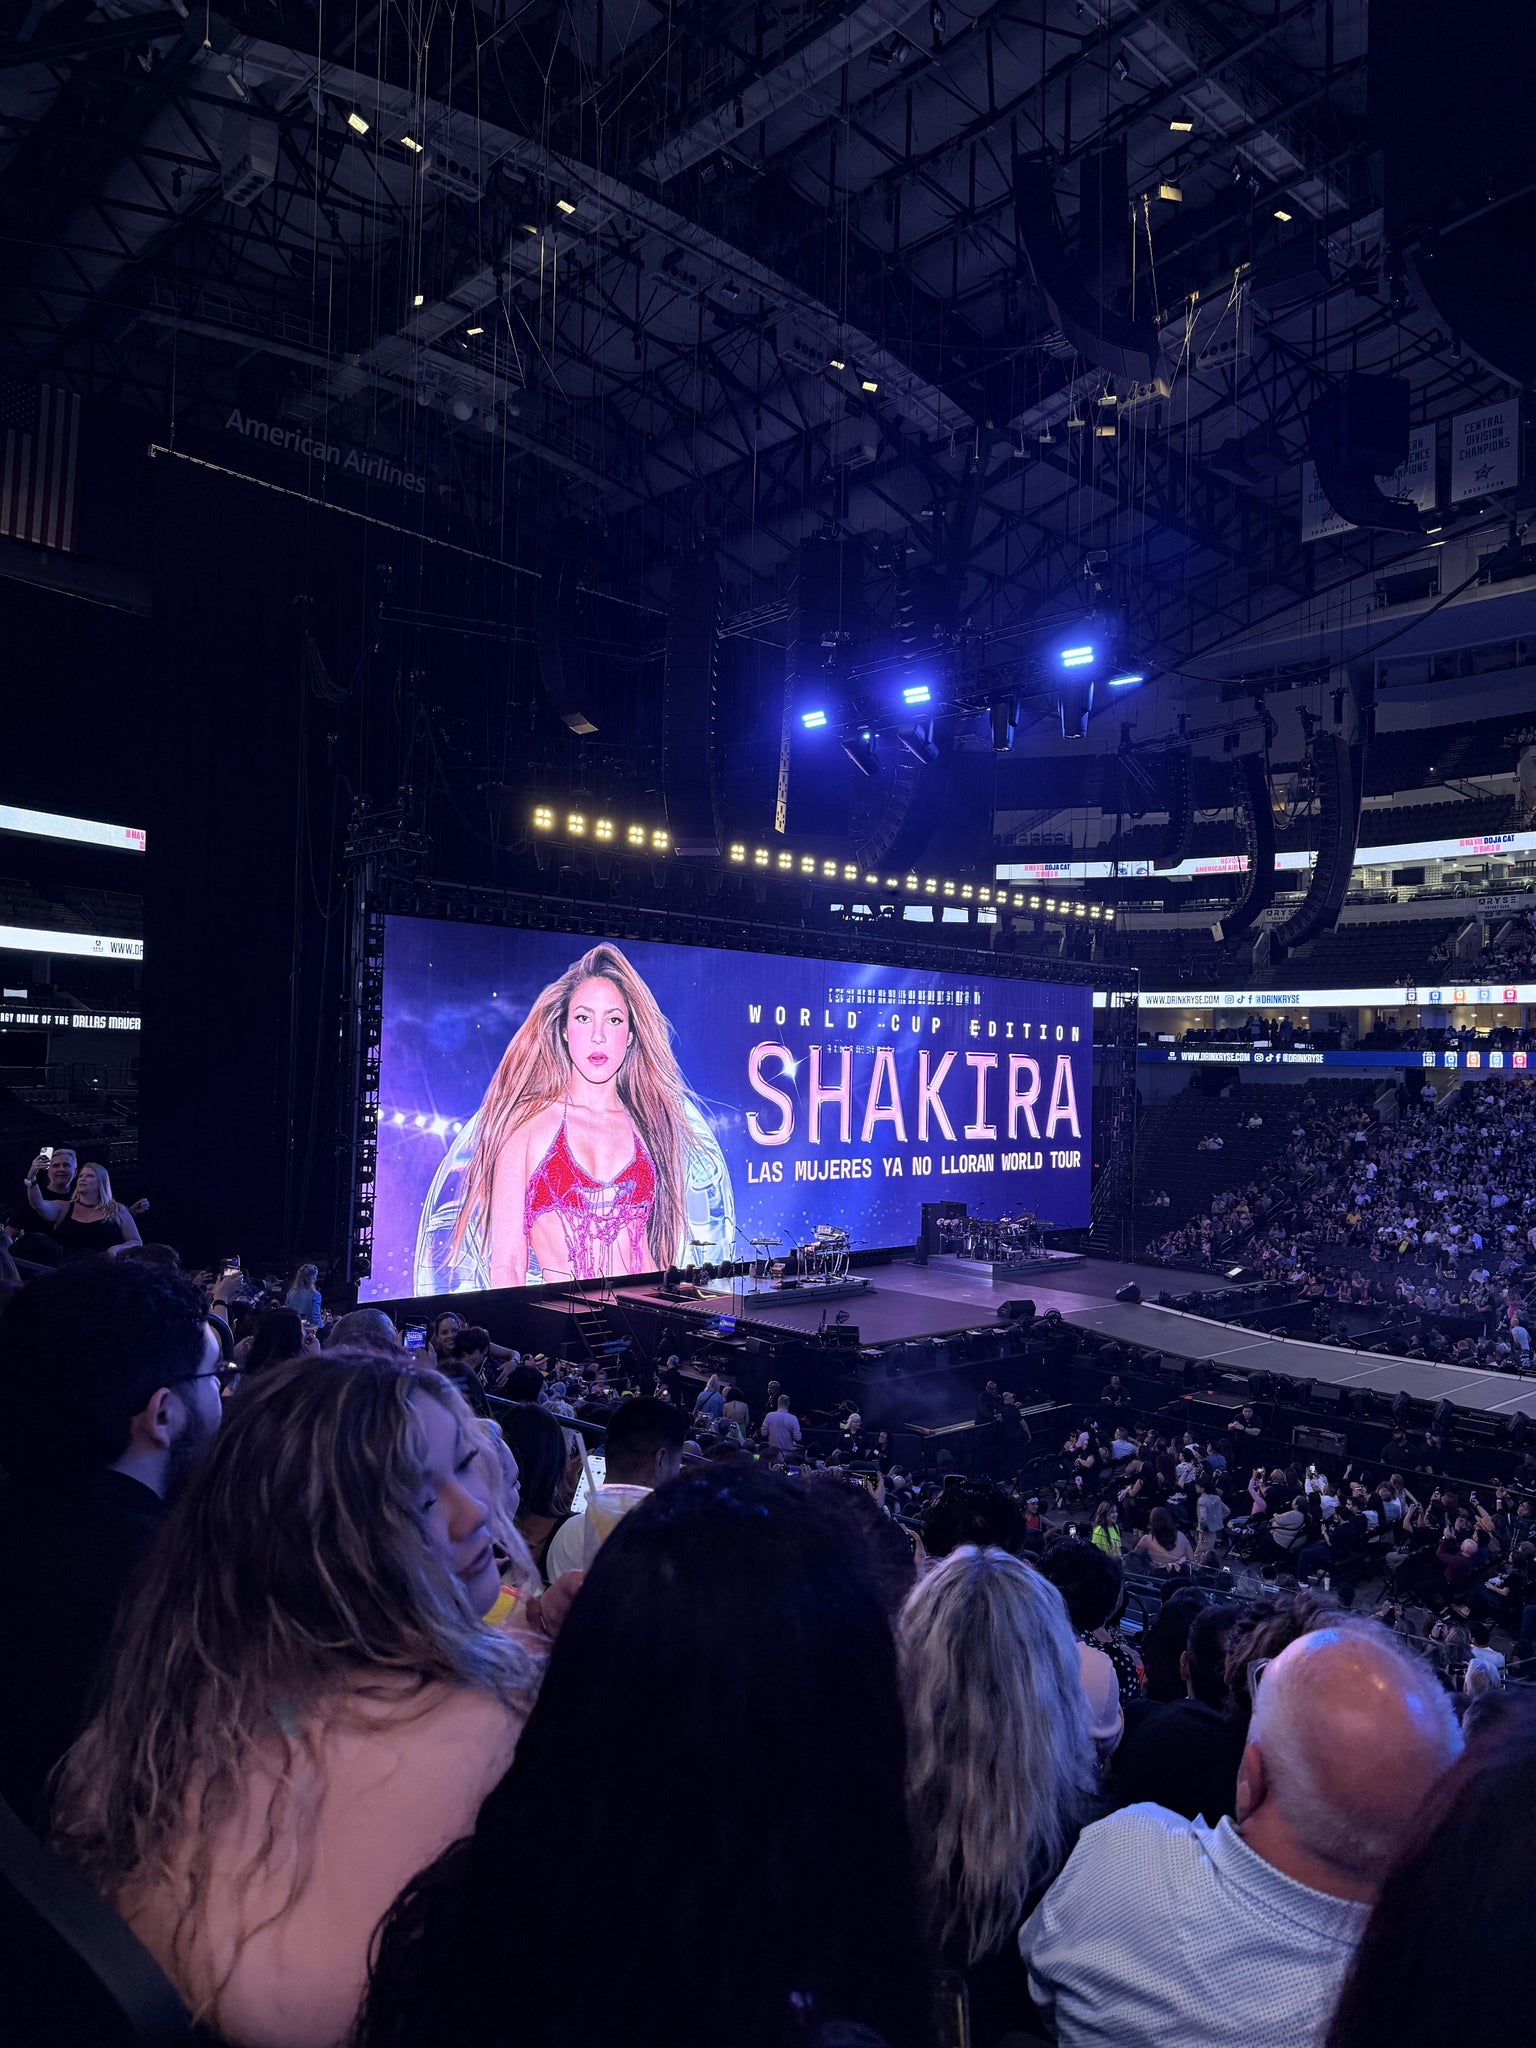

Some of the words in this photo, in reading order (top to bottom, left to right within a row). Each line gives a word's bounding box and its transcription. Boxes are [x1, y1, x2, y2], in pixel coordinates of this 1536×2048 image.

[1465, 414, 1505, 434] CENTRAL
[1466, 426, 1504, 446] DIVISION
[225, 408, 342, 465] American
[343, 448, 427, 494] Airlines
[1459, 436, 1510, 460] CHAMPIONS
[1484, 836, 1501, 844] DOJA
[1194, 864, 1226, 872] AMERICAN
[1487, 896, 1517, 904] RYSE
[1146, 995, 1220, 1005] WWW.DRINKRYSE.COM
[1256, 994, 1300, 1004] @DRINKRYSE
[16, 1014, 39, 1024] DRINK
[42, 1015, 52, 1024] OF
[54, 1016, 69, 1025] THE
[73, 1014, 106, 1028] DALLAS
[748, 1004, 858, 1030] WORLD
[890, 1014, 942, 1035] CUP
[968, 1018, 1081, 1042] EDITION
[1181, 1052, 1250, 1062] WWW.DRINKRYSE.COM
[1282, 1053, 1324, 1063] @DRINKRYSE
[746, 1040, 1082, 1146] SHAKIRA
[747, 1160, 784, 1184] LAS
[794, 1158, 872, 1182] MUJERES
[882, 1156, 903, 1178] YA
[912, 1155, 932, 1176] NO
[940, 1153, 994, 1176] LLORAN
[1002, 1152, 1042, 1172] WORLD
[1050, 1150, 1082, 1169] TOUR
